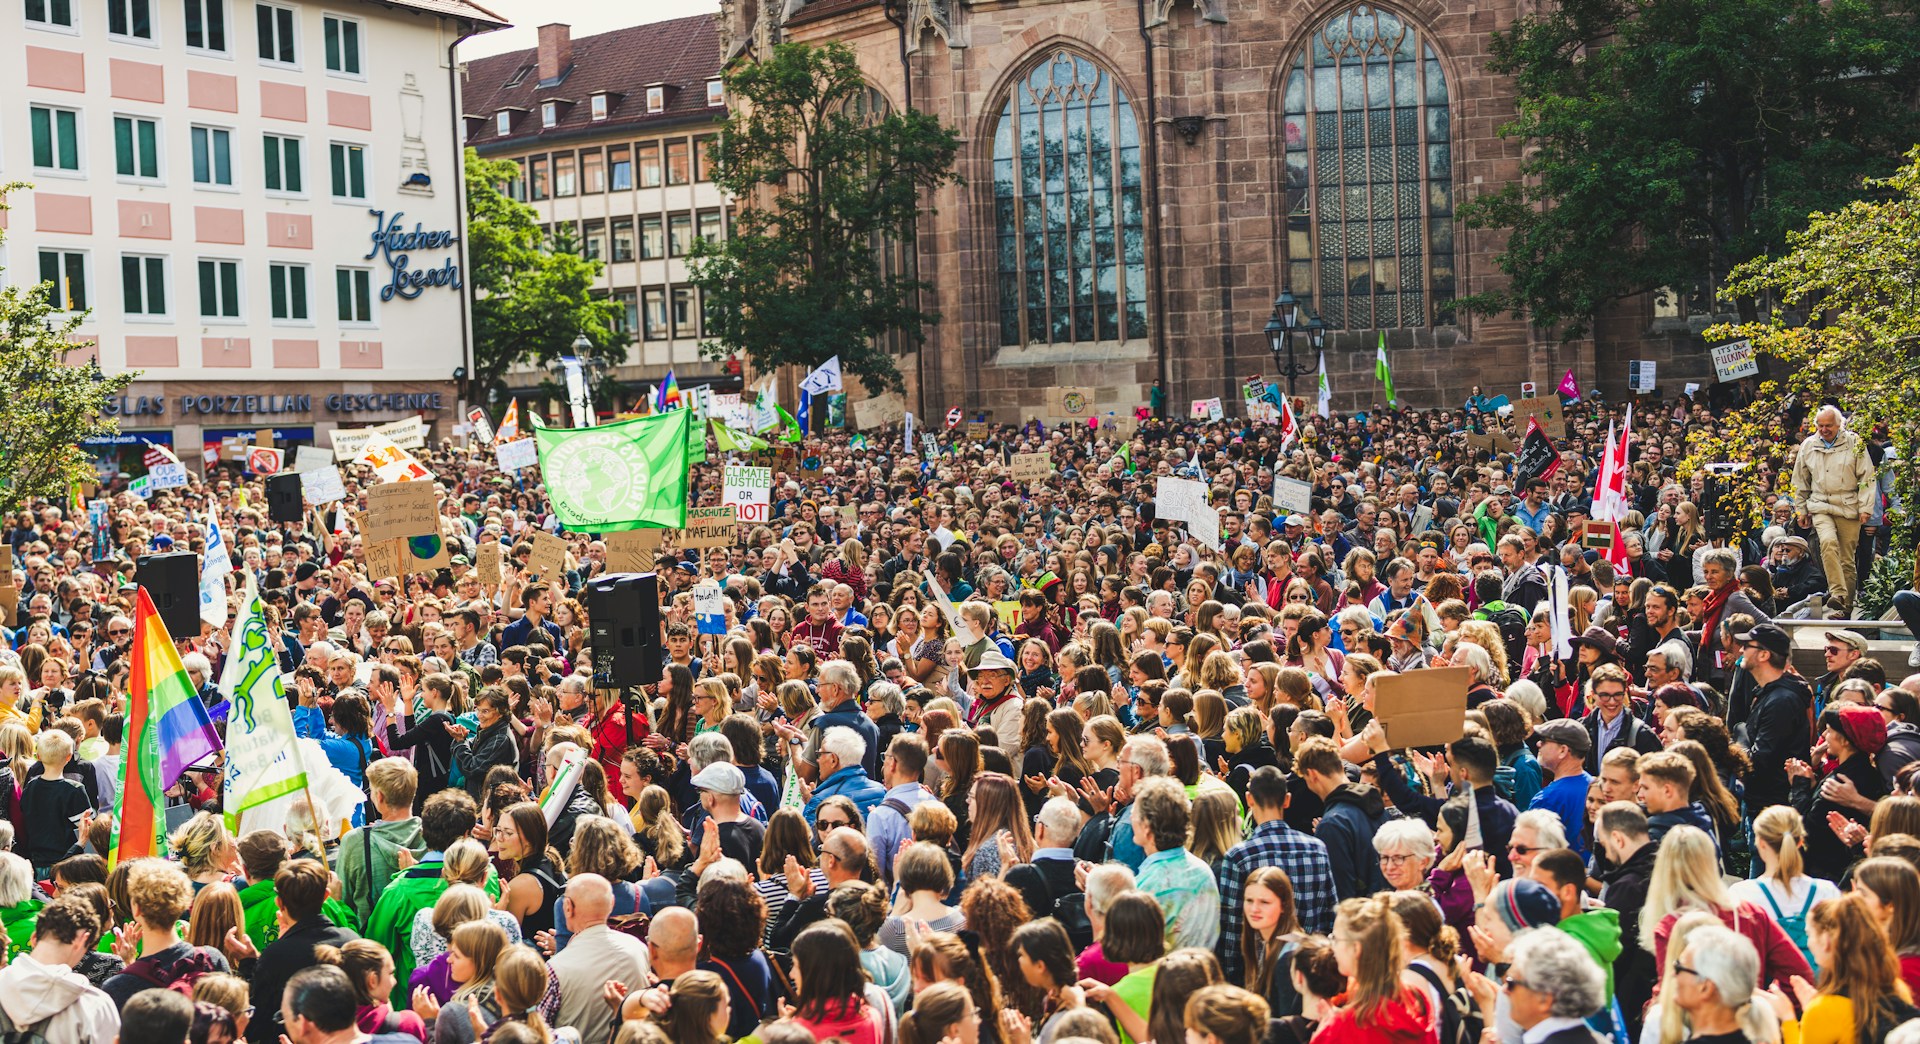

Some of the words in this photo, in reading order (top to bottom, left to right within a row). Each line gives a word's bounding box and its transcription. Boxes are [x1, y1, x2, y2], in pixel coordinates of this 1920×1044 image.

[364, 209, 460, 261] Küchen-
[381, 254, 462, 302] Loesch
[1716, 346, 1732, 355] IT'S
[1733, 341, 1748, 351] OUR
[1718, 361, 1755, 377] FUTURE
[103, 395, 166, 416] GLAS
[181, 393, 312, 416] PORZELLAN
[325, 392, 443, 412] GESCHENKE
[335, 433, 370, 443] Kerosin
[156, 465, 176, 476] OUR
[725, 467, 770, 479] CLIMATE
[152, 474, 186, 487] FUTURE
[725, 478, 770, 488] JUSTICE
[738, 490, 753, 500] OR
[687, 507, 731, 518] MASCHUTZ
[692, 518, 715, 526] STATT
[674, 525, 735, 541] KIMAFLUCHT
[540, 543, 562, 555] GOTT
